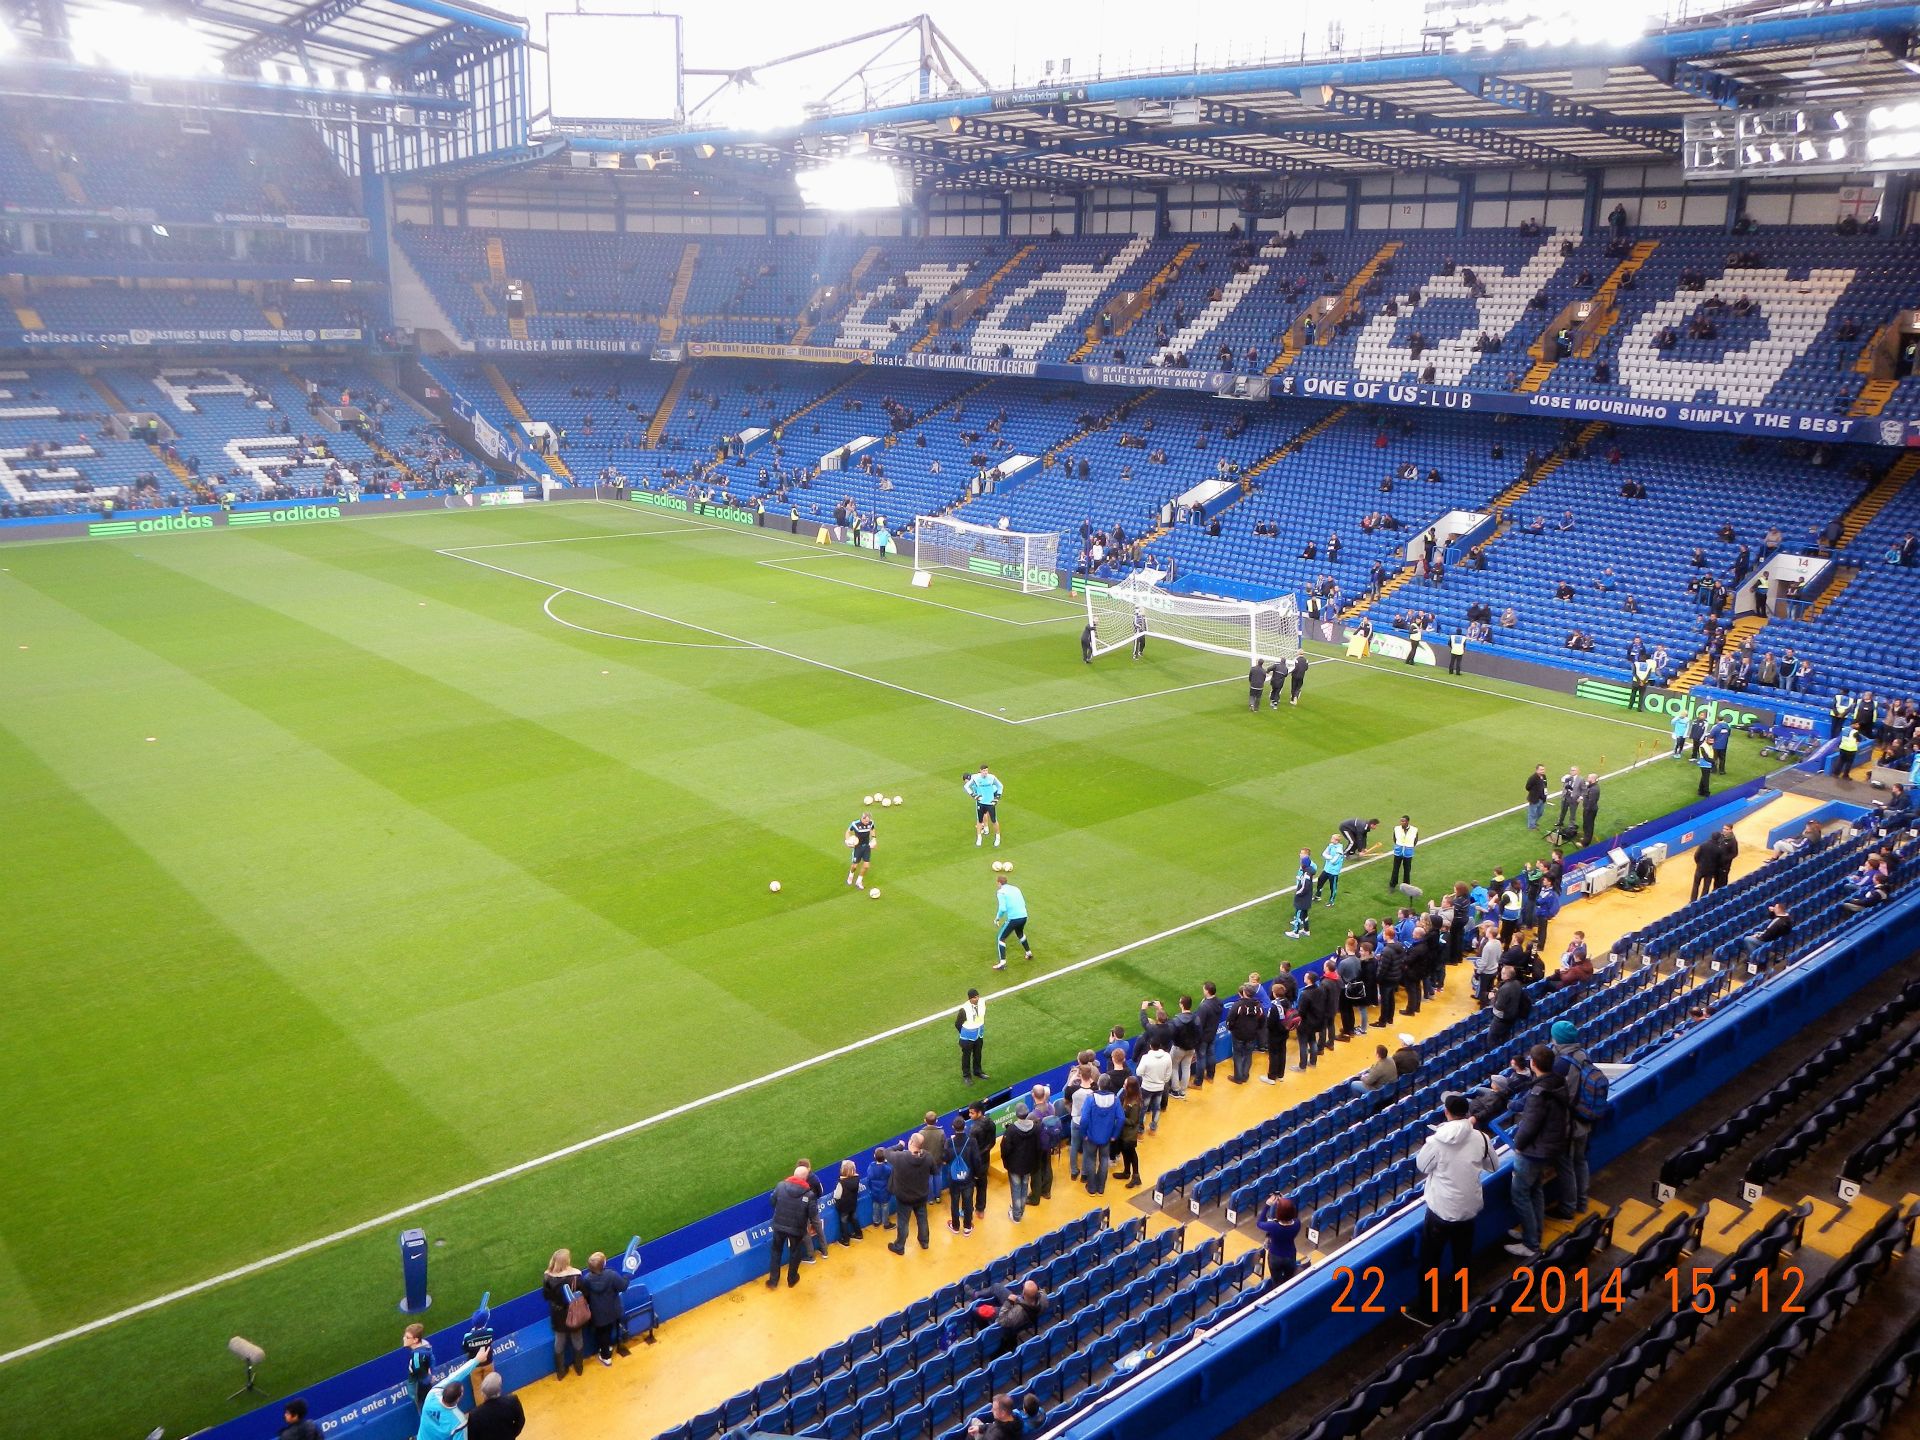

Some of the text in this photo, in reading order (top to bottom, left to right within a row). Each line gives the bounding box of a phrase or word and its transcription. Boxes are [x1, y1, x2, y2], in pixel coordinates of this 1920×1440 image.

[1656, 200, 1667, 210] 13
[500, 339, 626, 351] CHELSEA OUR RELIGION
[742, 345, 765, 355] PLACE
[1102, 374, 1127, 384] BLUE
[1138, 376, 1170, 386] WHITE
[1174, 378, 1206, 389] ARMY
[1303, 378, 1418, 403] ONE OF US
[1529, 395, 1854, 434] JOSE MOURINHO SIMPLY THE BEST
[652, 493, 687, 512] adidas
[272, 505, 341, 522] adidas
[715, 505, 754, 525] adidas
[138, 514, 214, 532] adidas
[1644, 693, 1759, 727] adidas
[1661, 1189, 1670, 1198] A
[1748, 1189, 1757, 1198] B
[1844, 1186, 1854, 1197] C
[752, 1231, 759, 1240] It
[760, 1227, 767, 1237] is
[322, 1419, 338, 1432] Do
[340, 1408, 359, 1423] not
[361, 1398, 388, 1415] enter
[390, 1386, 408, 1404] yell
